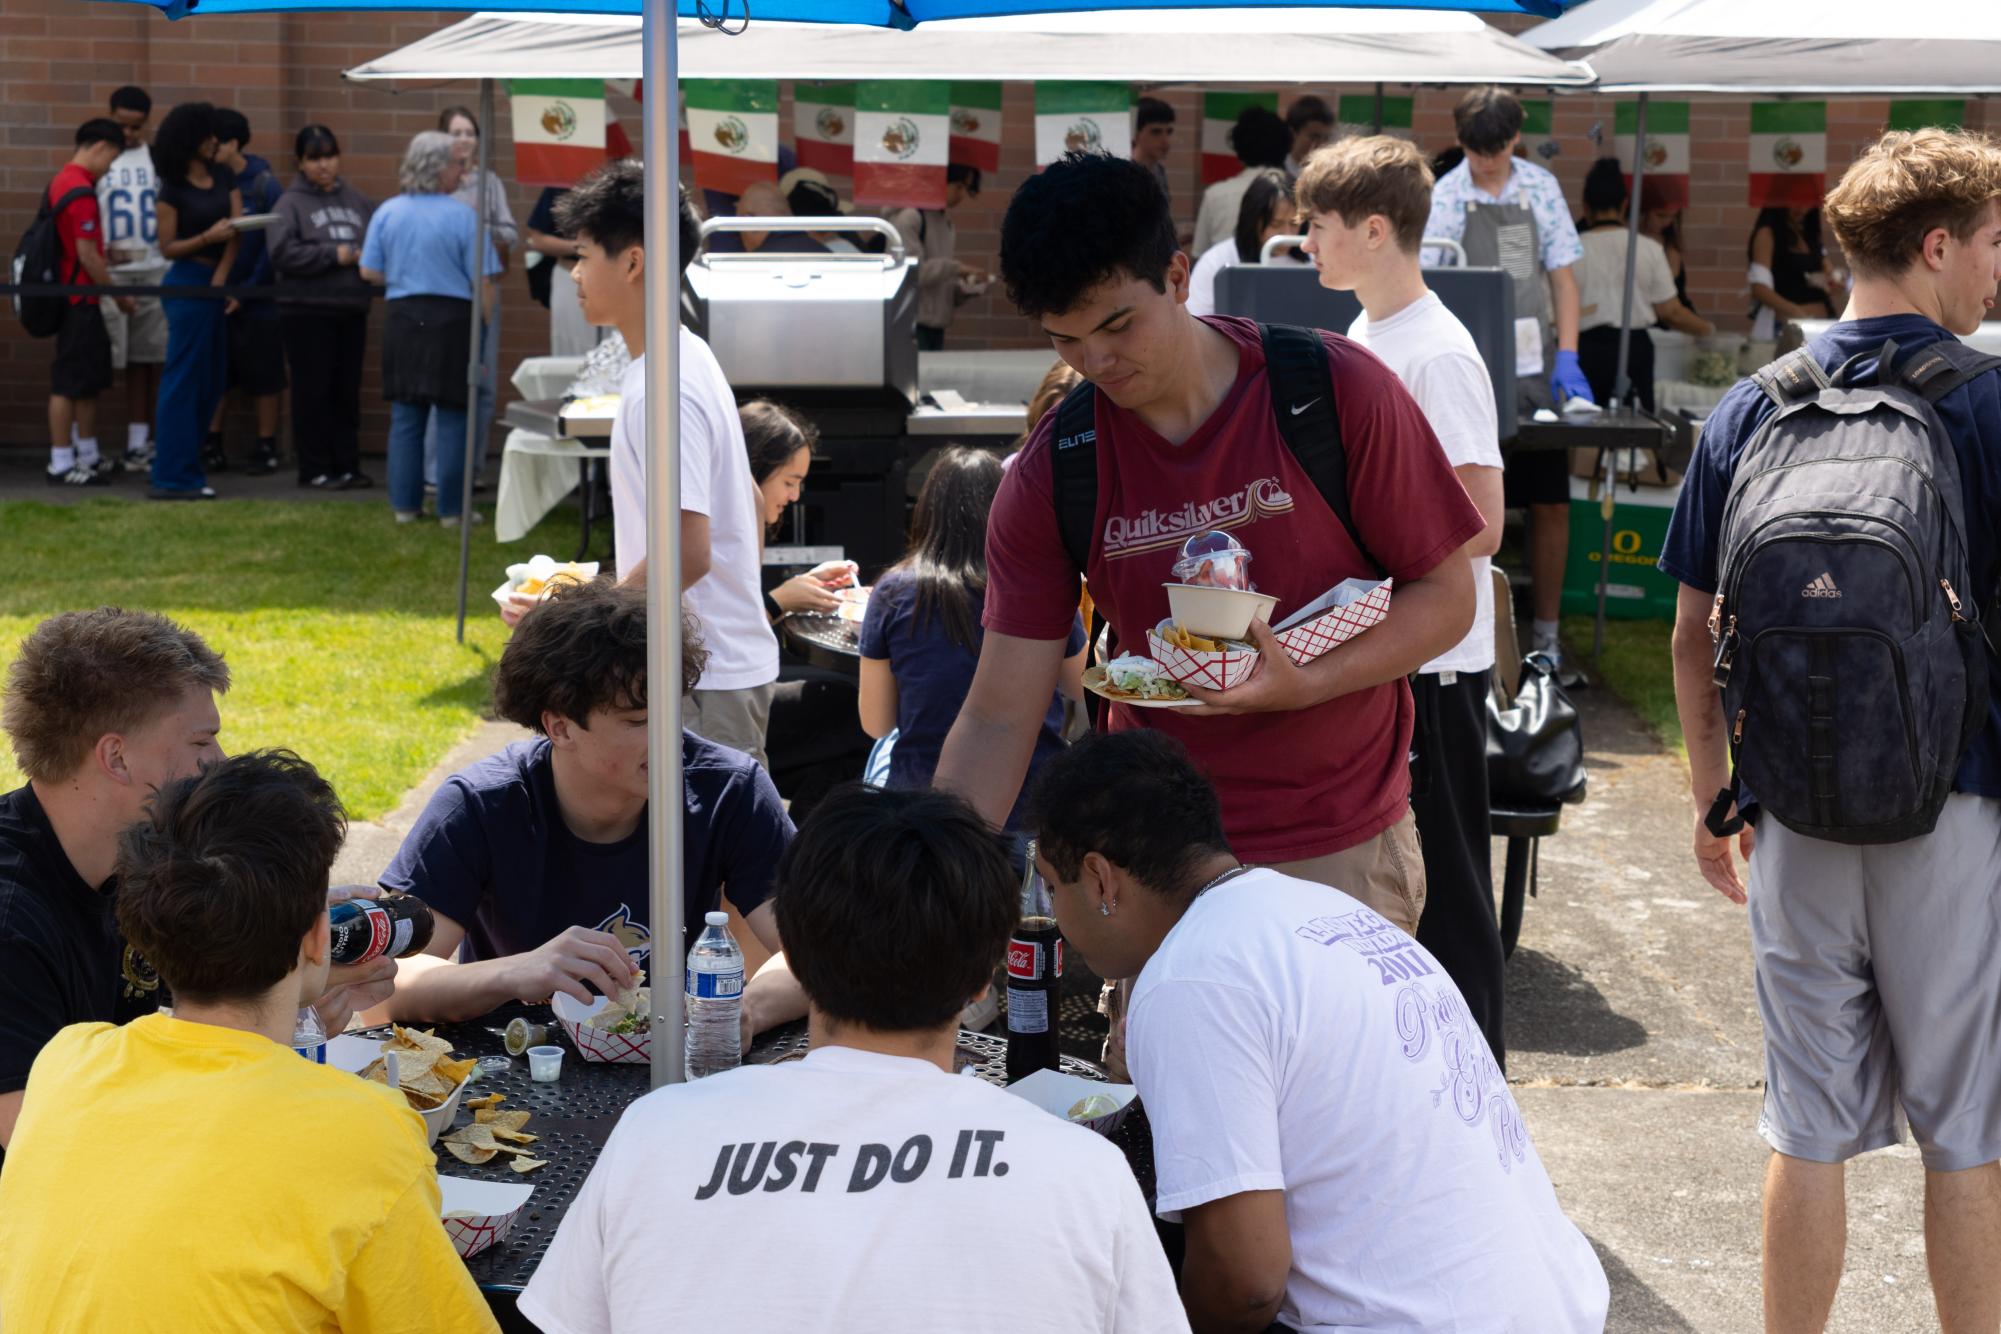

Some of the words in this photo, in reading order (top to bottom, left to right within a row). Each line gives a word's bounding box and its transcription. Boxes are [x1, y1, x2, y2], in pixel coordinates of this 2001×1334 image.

[1058, 430, 1097, 450] ELITE
[1103, 488, 1246, 547] Quiksilver
[1801, 588, 1842, 598] adidas
[1367, 949, 1437, 986] 2011
[694, 1140, 840, 1200] JUST
[846, 1134, 933, 1193] DO
[947, 1129, 1010, 1179] IT.
